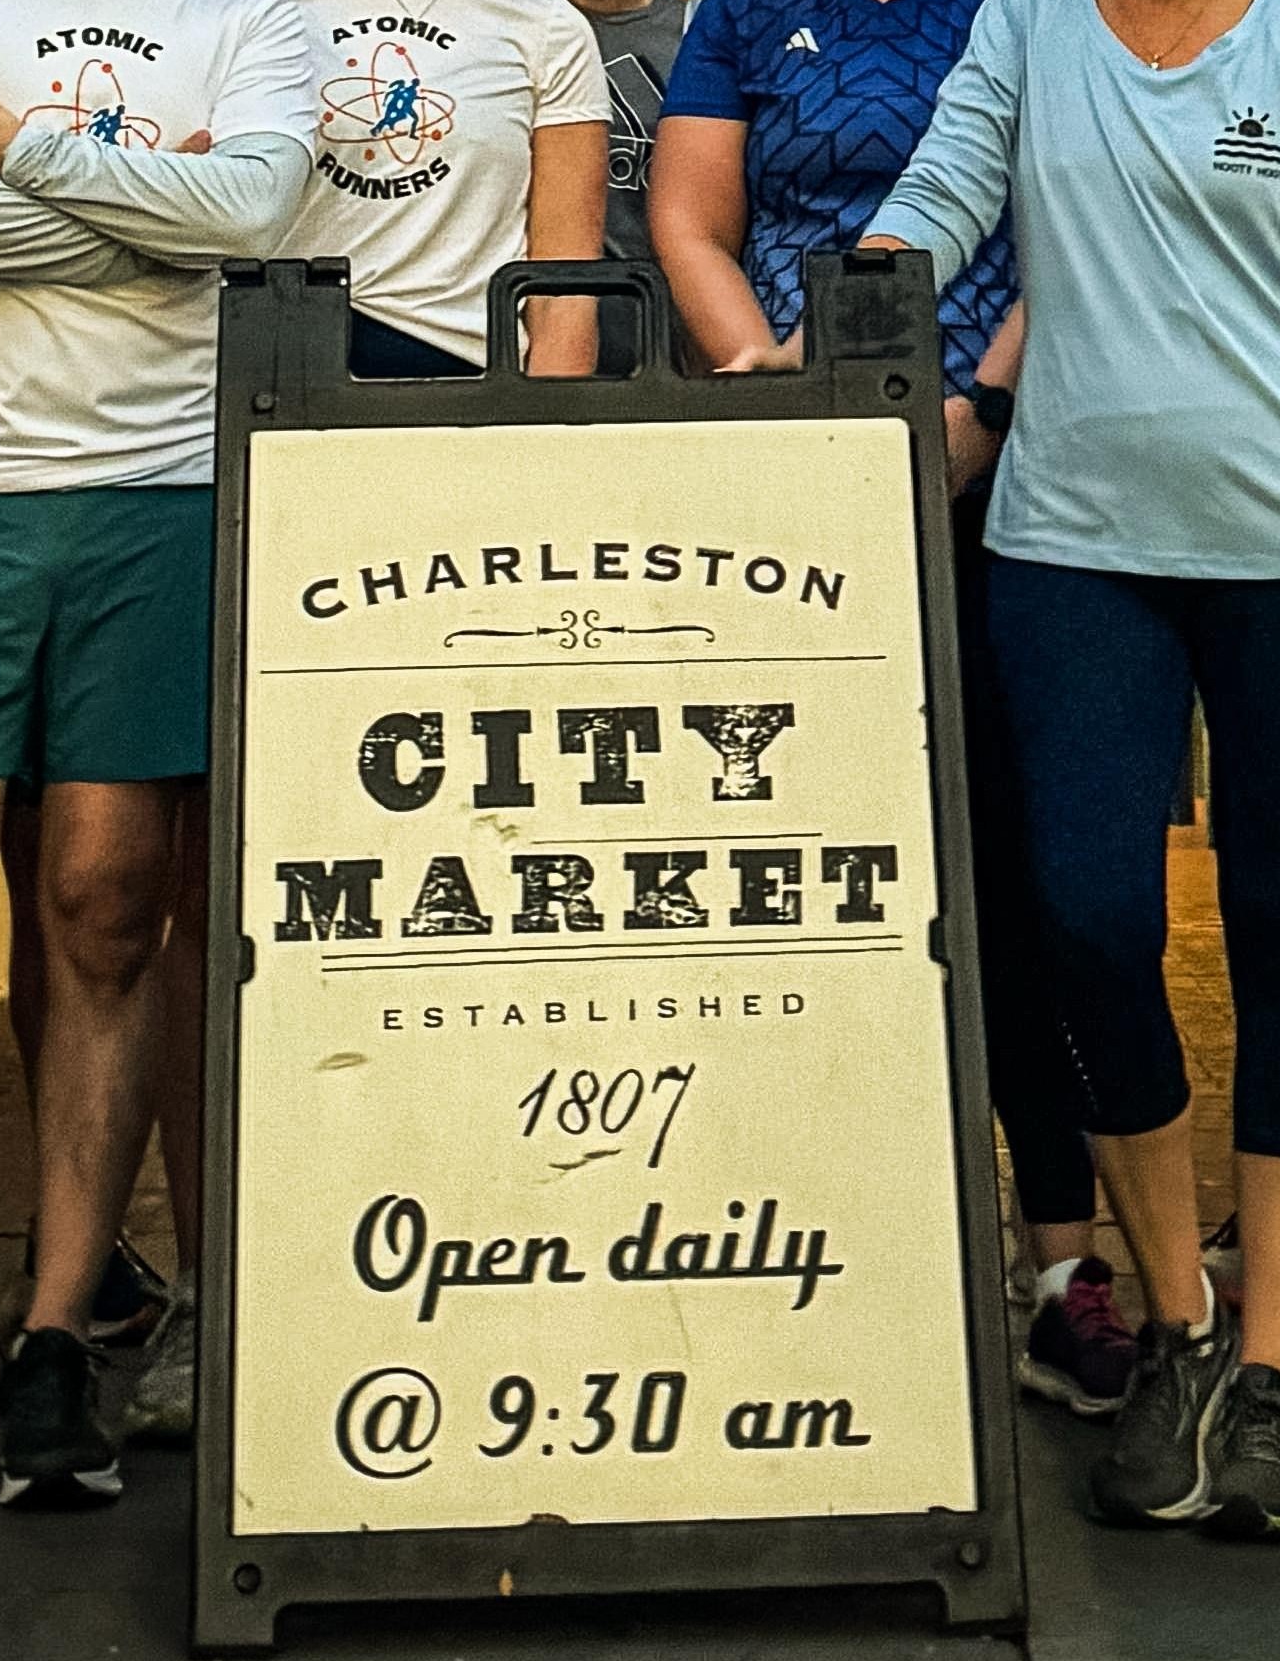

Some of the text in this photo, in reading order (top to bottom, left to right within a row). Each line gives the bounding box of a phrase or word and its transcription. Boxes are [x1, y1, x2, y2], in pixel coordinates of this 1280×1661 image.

[36, 27, 164, 62] ATOMIC
[332, 16, 456, 50] ATOMIC
[315, 152, 451, 200] RUNNERS
[301, 542, 846, 619] CHARLESTON
[357, 702, 796, 813] CITY
[274, 844, 899, 943] MARKET
[383, 993, 806, 1030] ESTABLISHED
[518, 1063, 697, 1170] 1807
[353, 1194, 845, 1323] Open daily
[335, 1366, 872, 1480] @ 9:30 am
